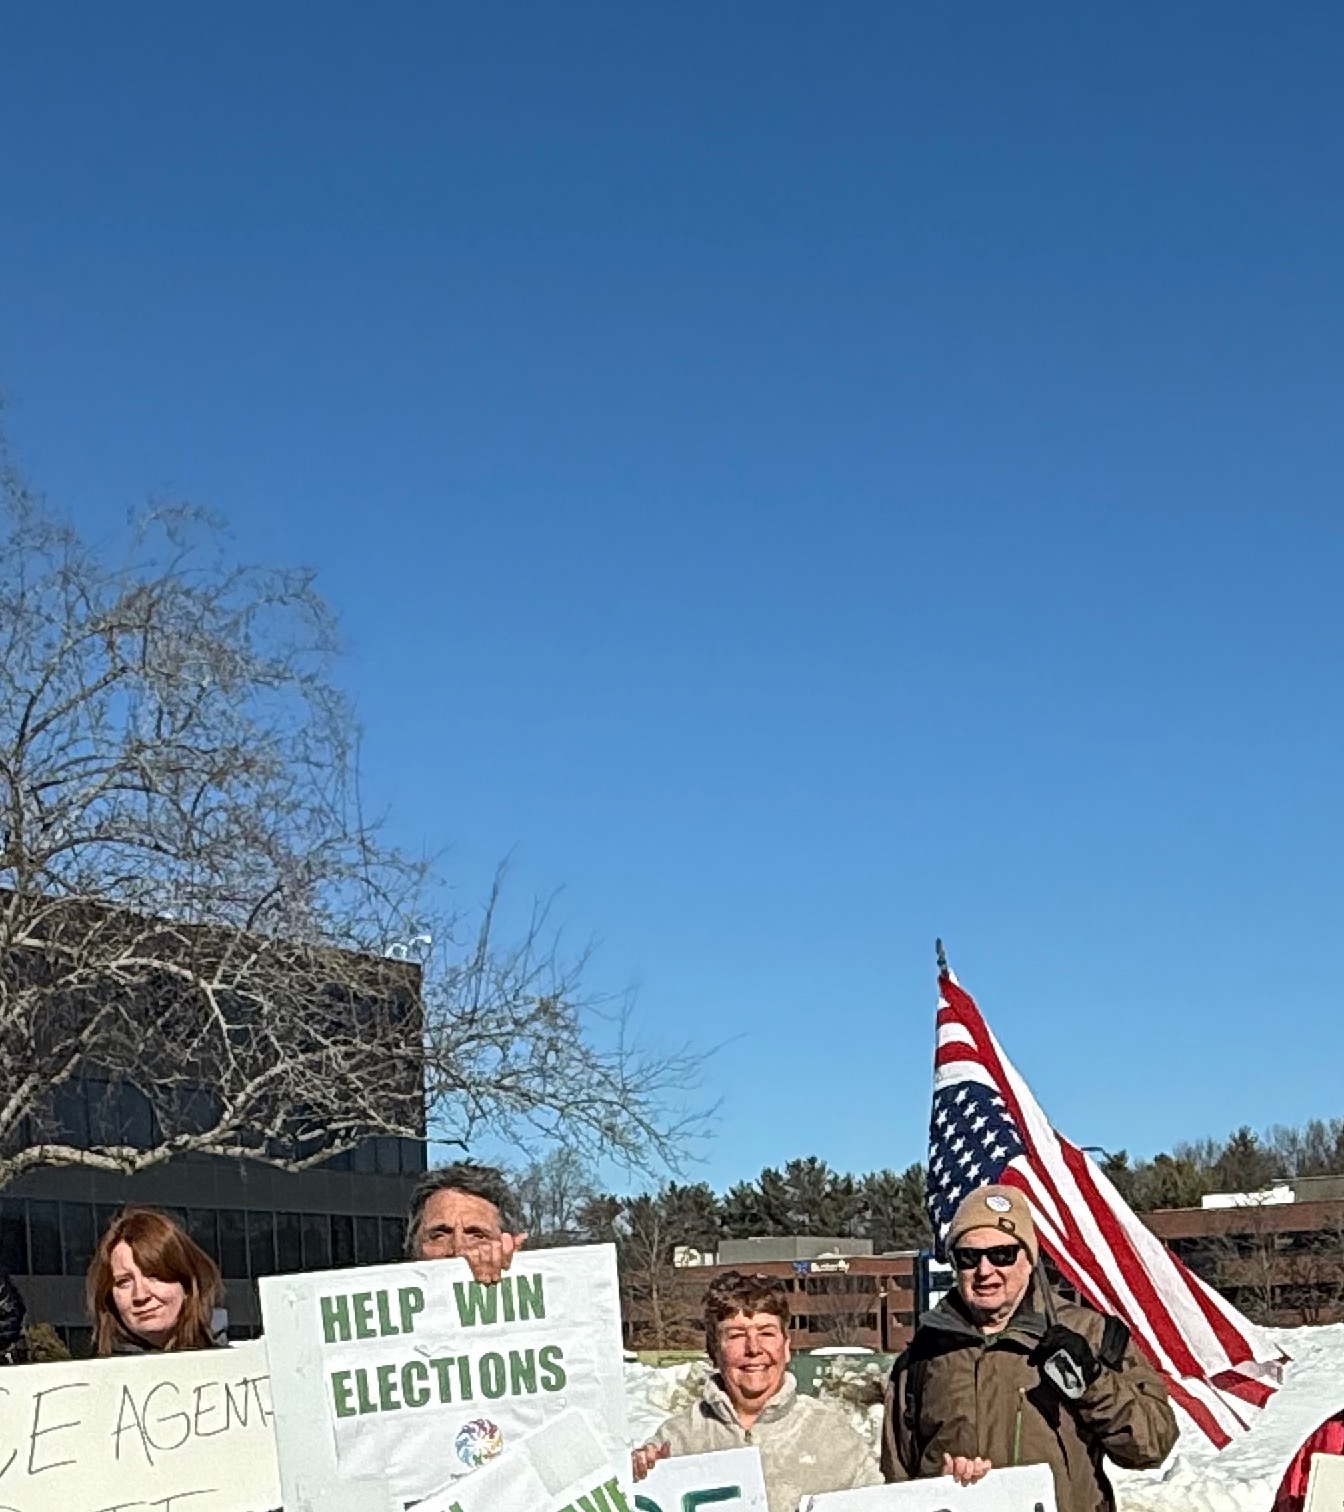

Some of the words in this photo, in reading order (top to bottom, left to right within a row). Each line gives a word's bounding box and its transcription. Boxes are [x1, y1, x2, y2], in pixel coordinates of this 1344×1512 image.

[320, 1285, 425, 1345] HELP
[453, 1273, 546, 1328] WIN
[330, 1345, 567, 1418] ELECTIONS
[111, 1375, 274, 1466] AGENT
